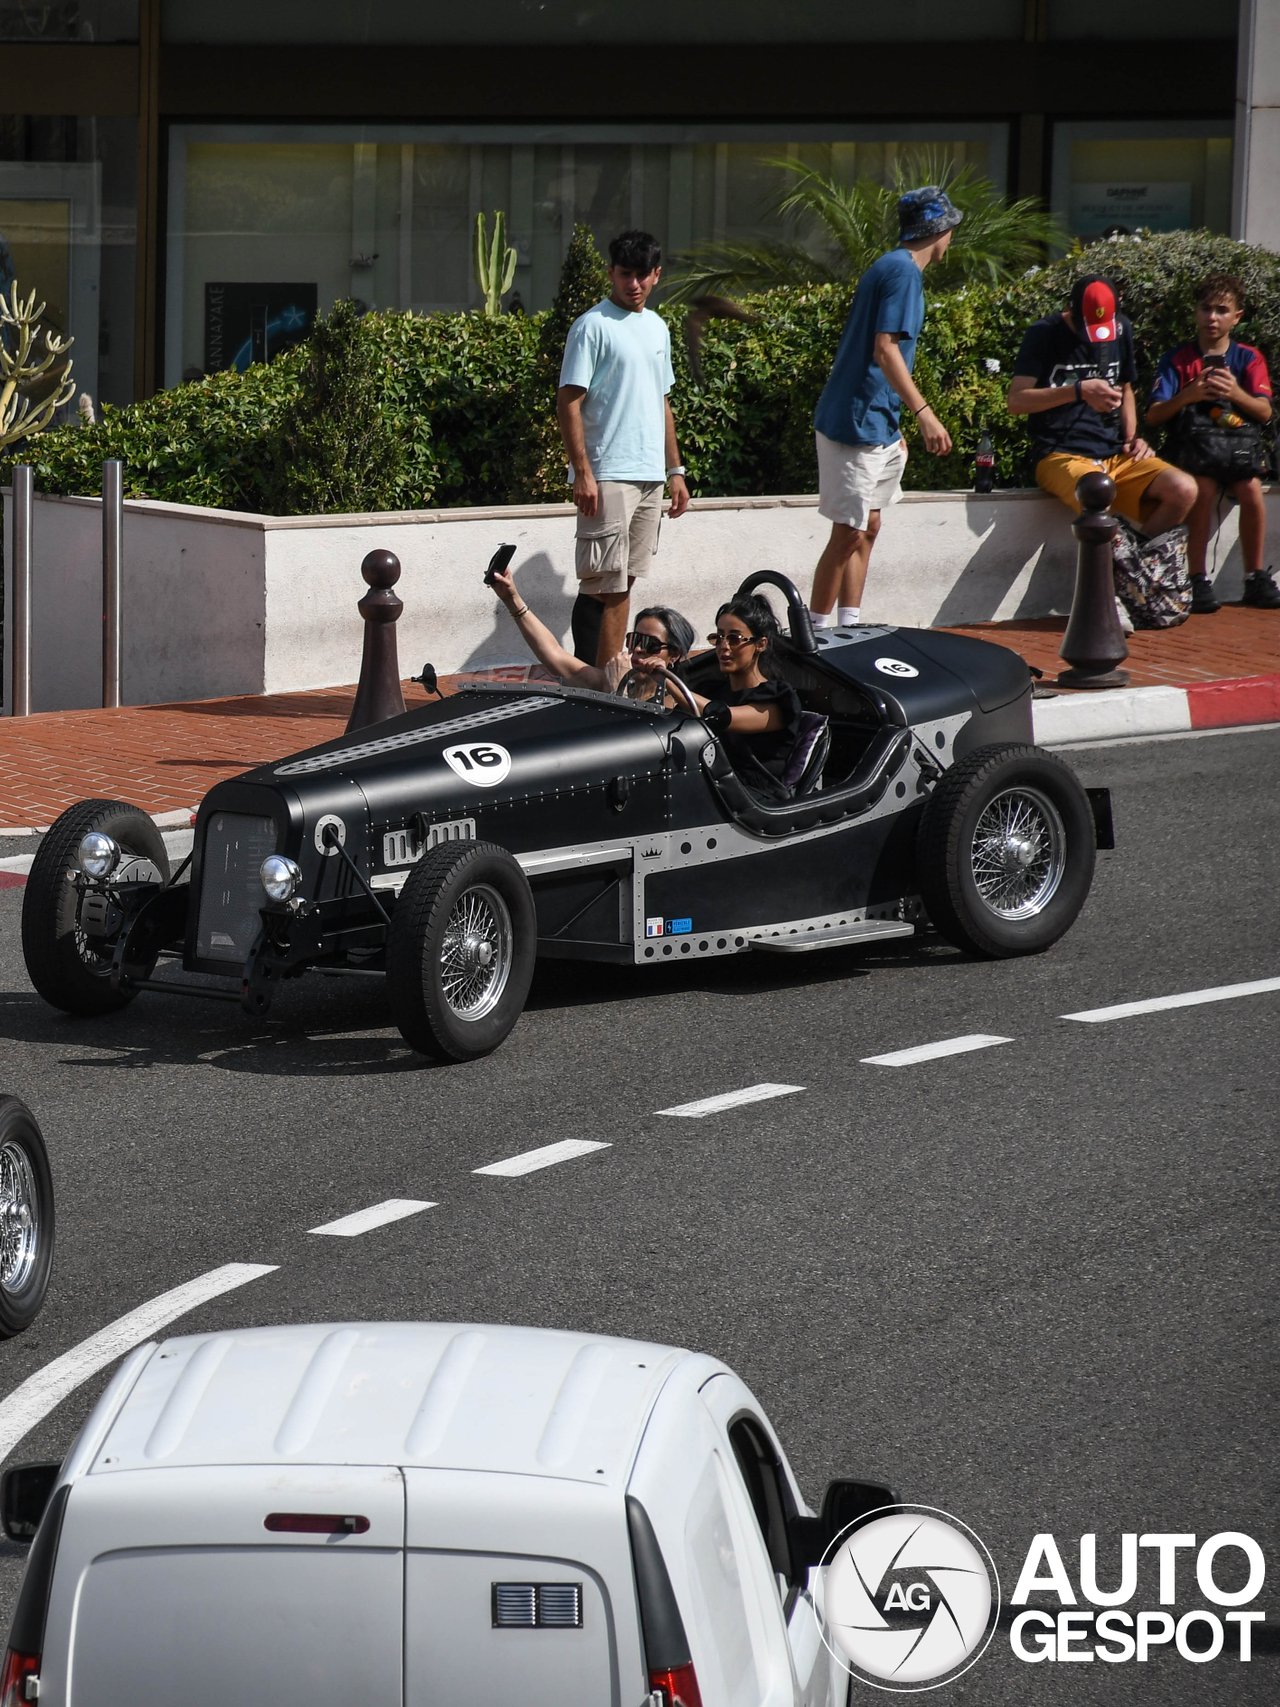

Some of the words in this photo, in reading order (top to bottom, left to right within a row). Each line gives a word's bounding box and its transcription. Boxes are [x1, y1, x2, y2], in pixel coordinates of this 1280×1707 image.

[209, 286, 224, 368] ANNAYAKE
[882, 664, 911, 674] 16
[452, 747, 503, 771] 16
